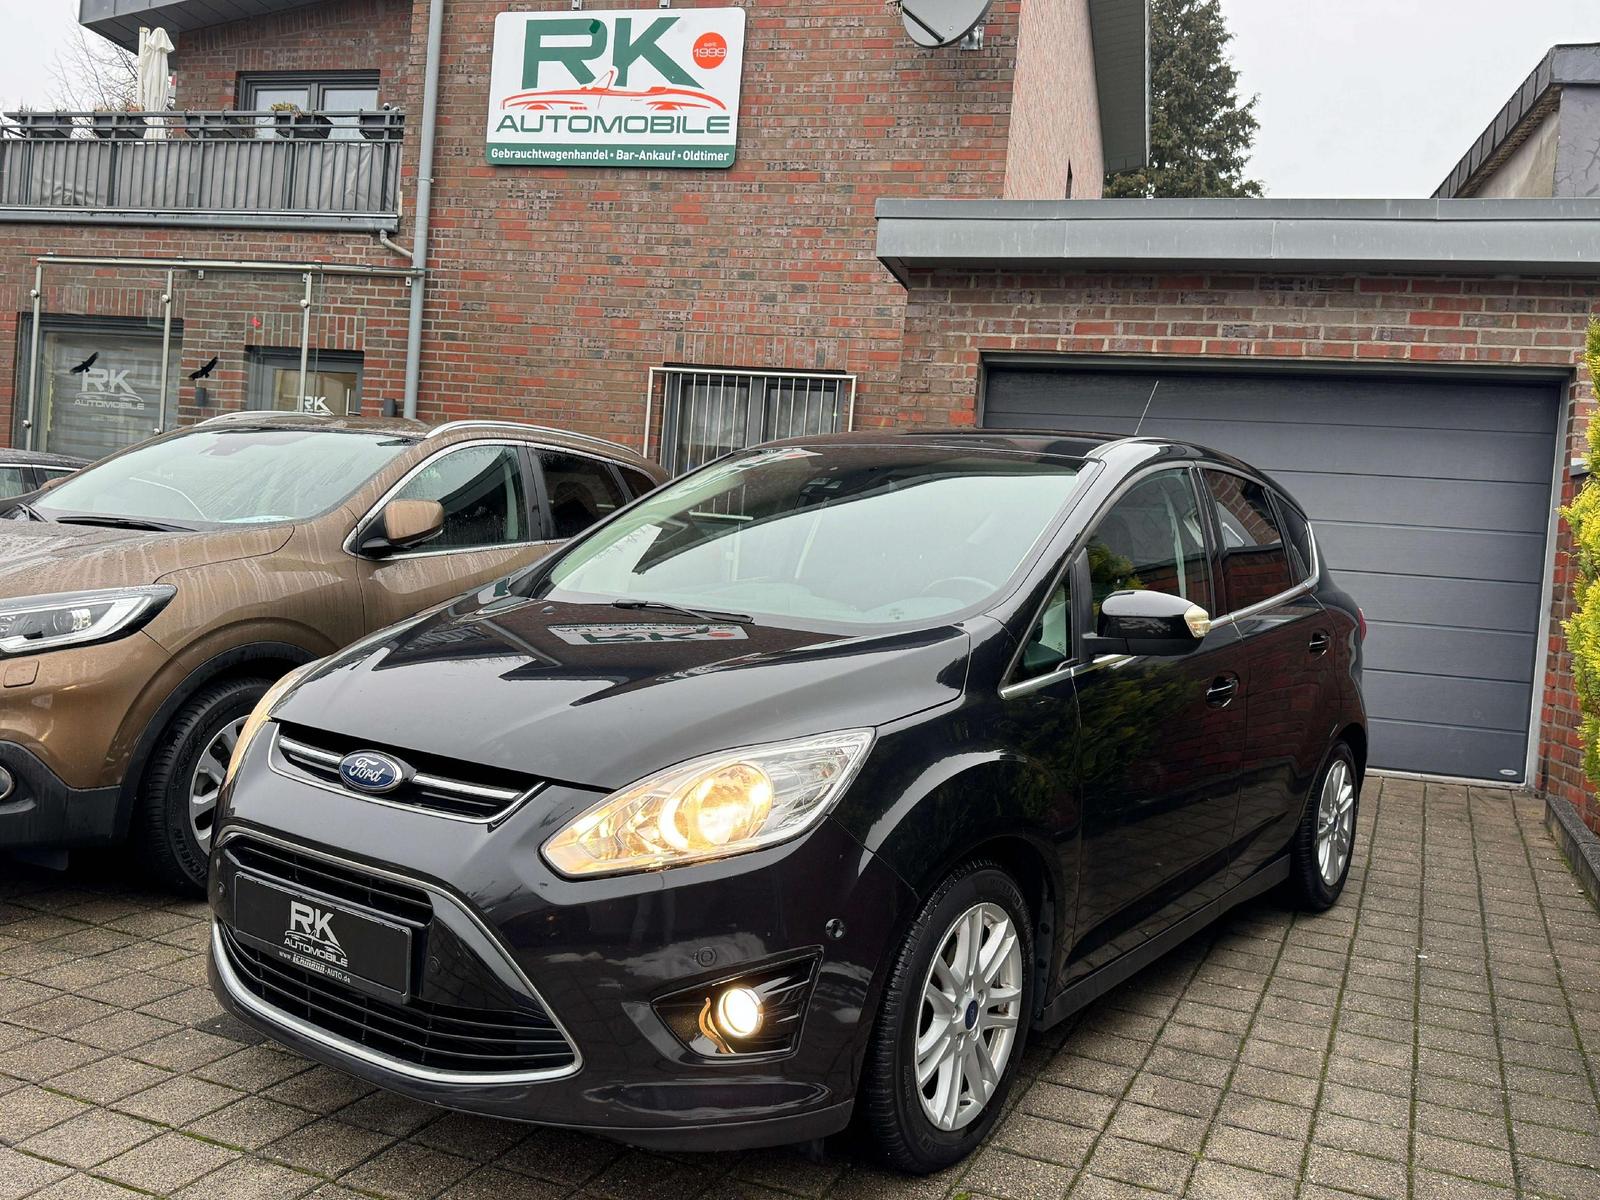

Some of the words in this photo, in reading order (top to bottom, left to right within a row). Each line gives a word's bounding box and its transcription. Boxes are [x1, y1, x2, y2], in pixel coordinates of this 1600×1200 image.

[521, 16, 705, 90] RK
[694, 47, 726, 58] 1999
[495, 114, 731, 135] AUTOMOBILE
[491, 148, 609, 161] Gebrauchtwagenhandel
[616, 149, 676, 161] Bar-Ankauf
[682, 149, 730, 162] Oldtimer
[81, 367, 137, 395] RK
[73, 399, 145, 411] AUTOMOBILE
[348, 757, 386, 783] Ford
[175, 829, 208, 880] ICHELIN
[290, 900, 341, 947] RK
[284, 937, 349, 968] AUTOMOBILE
